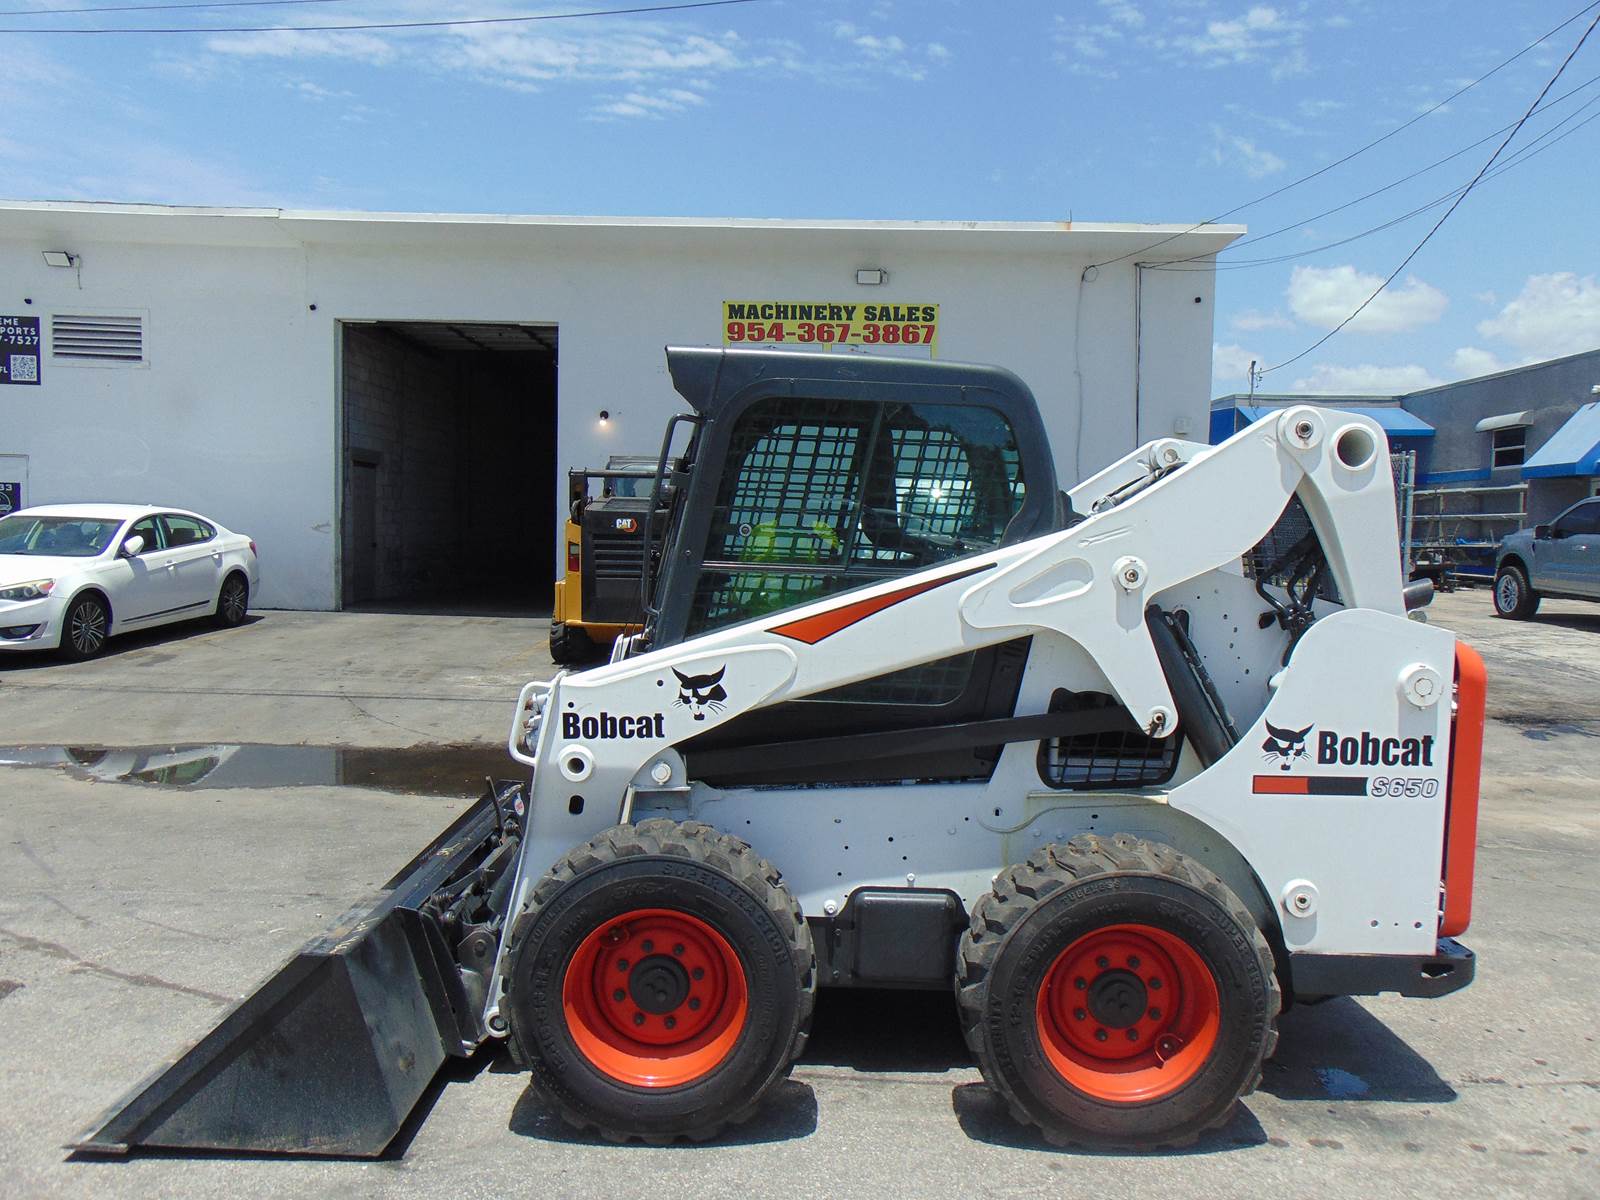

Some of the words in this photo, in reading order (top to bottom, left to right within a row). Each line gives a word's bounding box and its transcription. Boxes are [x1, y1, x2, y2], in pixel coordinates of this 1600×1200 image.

[728, 303, 856, 321] MACHINERY
[864, 306, 935, 322] SALES
[727, 322, 936, 344] 954-367-3867
[616, 518, 632, 529] CAT
[562, 712, 665, 740] Bobcat
[1317, 730, 1434, 767] Bobcat
[1371, 776, 1439, 798] S650
[1206, 906, 1250, 957] SUPER
